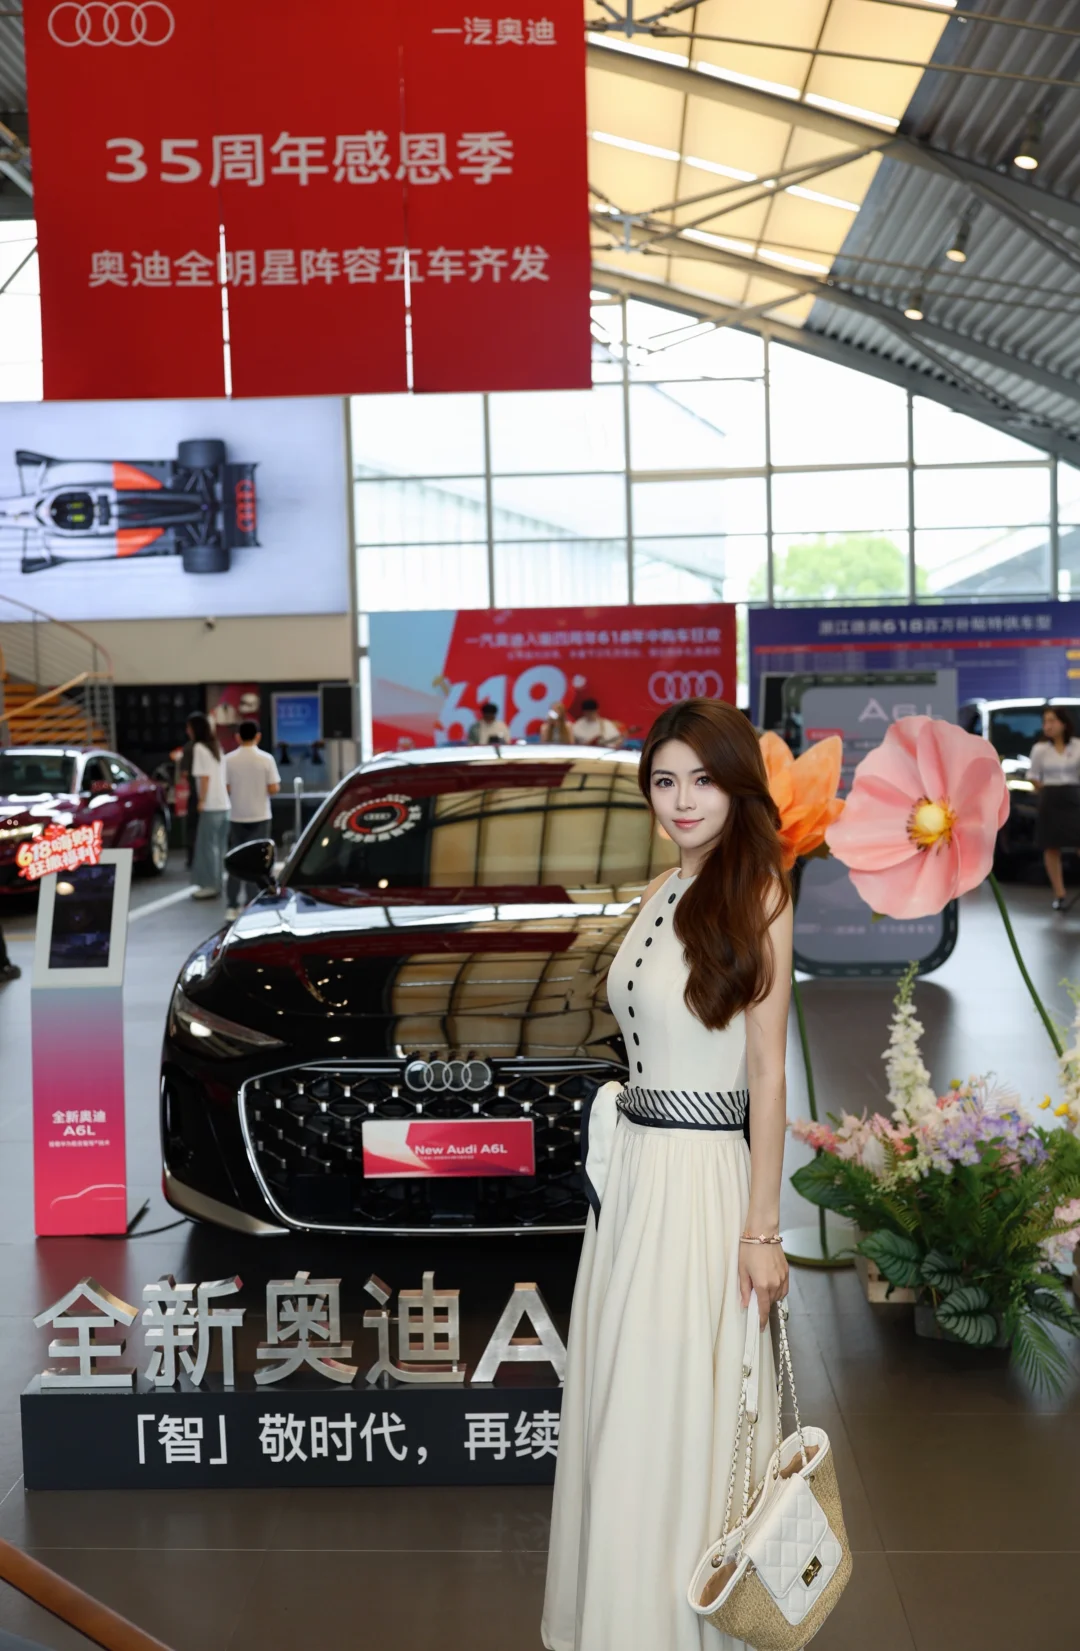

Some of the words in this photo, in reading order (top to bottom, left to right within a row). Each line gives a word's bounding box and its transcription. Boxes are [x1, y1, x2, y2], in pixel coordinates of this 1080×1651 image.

[432, 17, 557, 46] 一汽奥迪
[105, 131, 515, 187] 35周年感恩季
[88, 245, 551, 289] 奥迪全明星阵容五车齐发
[434, 664, 568, 747] 618
[52, 1109, 106, 1124] 全新奥迪
[63, 1125, 96, 1136] A6L
[414, 1144, 443, 1155] New
[447, 1144, 477, 1155] Audi
[480, 1143, 508, 1154] A6L
[32, 1270, 567, 1389] 全新奥迪A
